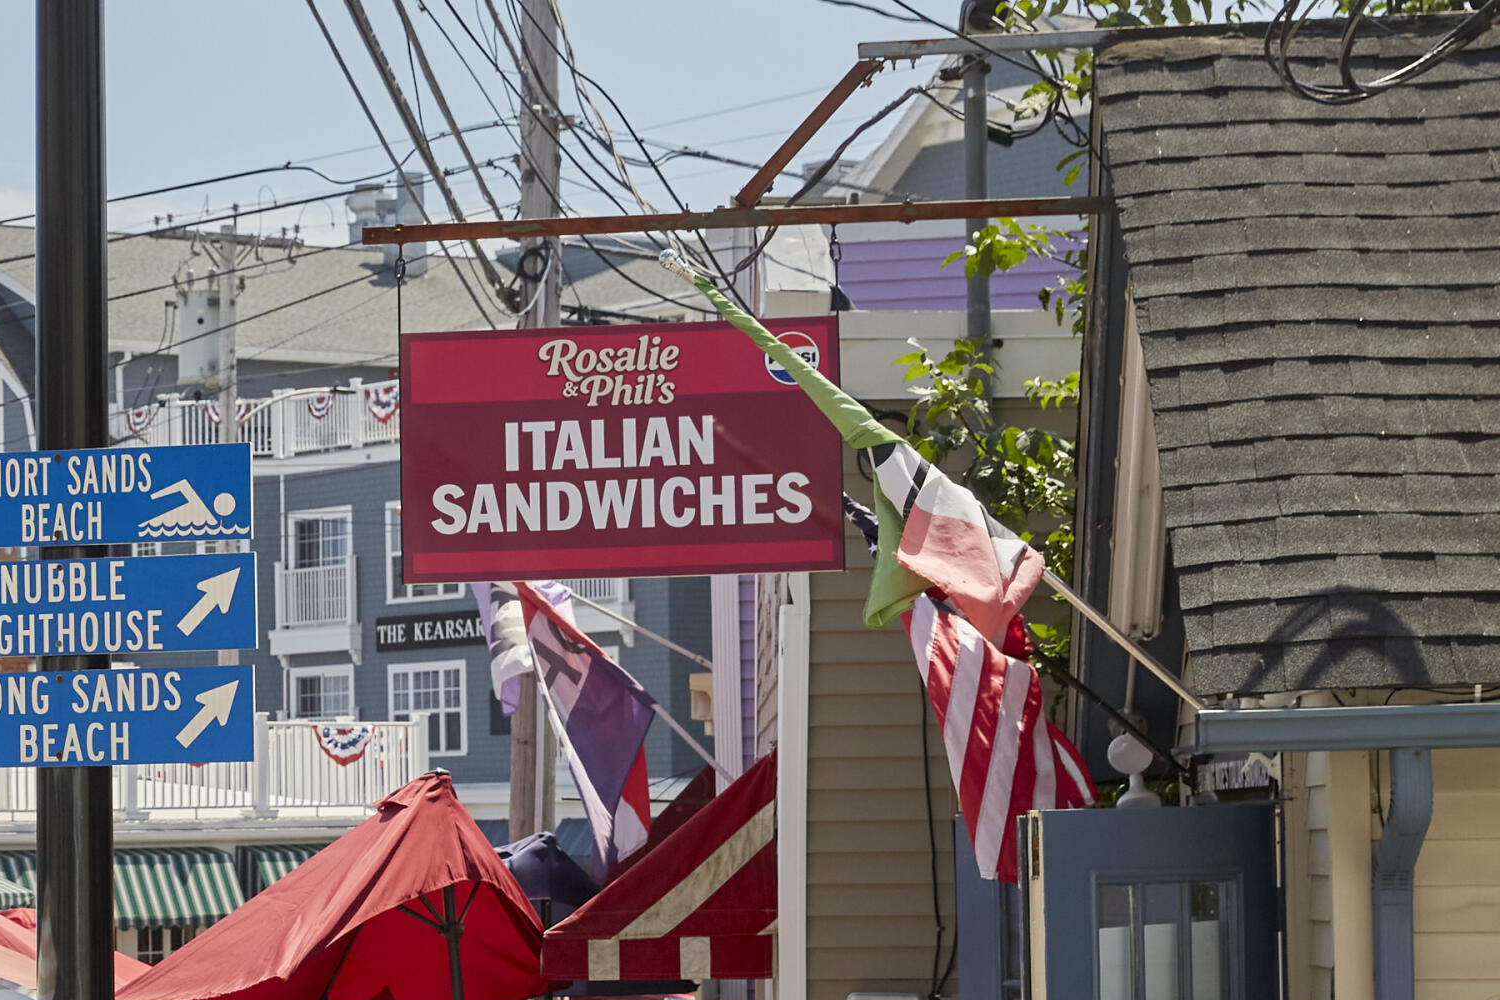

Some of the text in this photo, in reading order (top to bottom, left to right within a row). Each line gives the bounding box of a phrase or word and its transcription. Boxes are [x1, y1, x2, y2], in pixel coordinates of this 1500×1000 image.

[538, 334, 680, 383] Rosalie
[562, 373, 676, 407] & Phil's
[504, 415, 715, 472] ITALIAN
[67, 452, 152, 495] SANDS
[21, 501, 102, 543] BEACH
[431, 472, 813, 536] SANDWICHES
[1, 560, 126, 604] NUBBLE
[377, 618, 486, 644] THE KEARSAR
[71, 671, 181, 714] SANDS
[19, 721, 130, 763] BEACH
